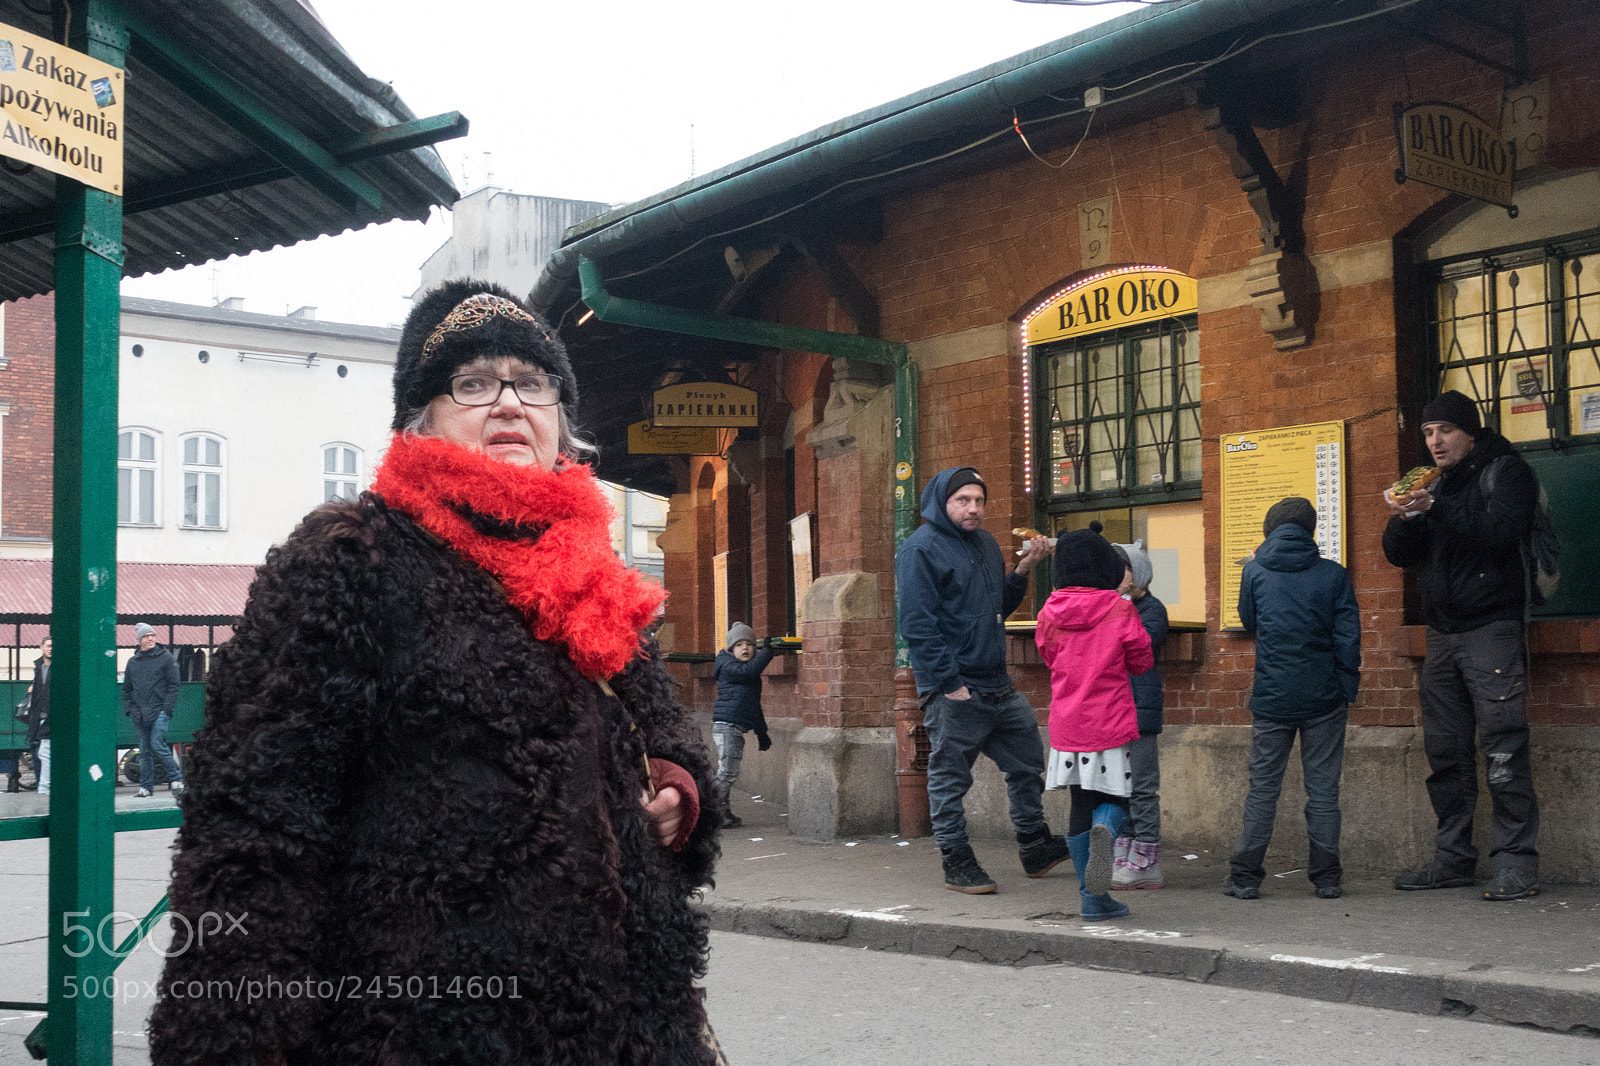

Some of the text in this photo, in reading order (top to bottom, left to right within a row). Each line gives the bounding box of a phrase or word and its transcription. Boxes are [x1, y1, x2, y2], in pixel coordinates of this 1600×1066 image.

[22, 45, 88, 92] Zakaz
[0, 83, 118, 141] pożywania
[3, 119, 103, 174] Alkoholu
[1410, 113, 1455, 161] BAR
[1089, 240, 1101, 260] 9
[1058, 278, 1180, 331] BAR OKO
[656, 404, 756, 416] ZAPIEKANKI
[685, 391, 727, 400] Piecyk
